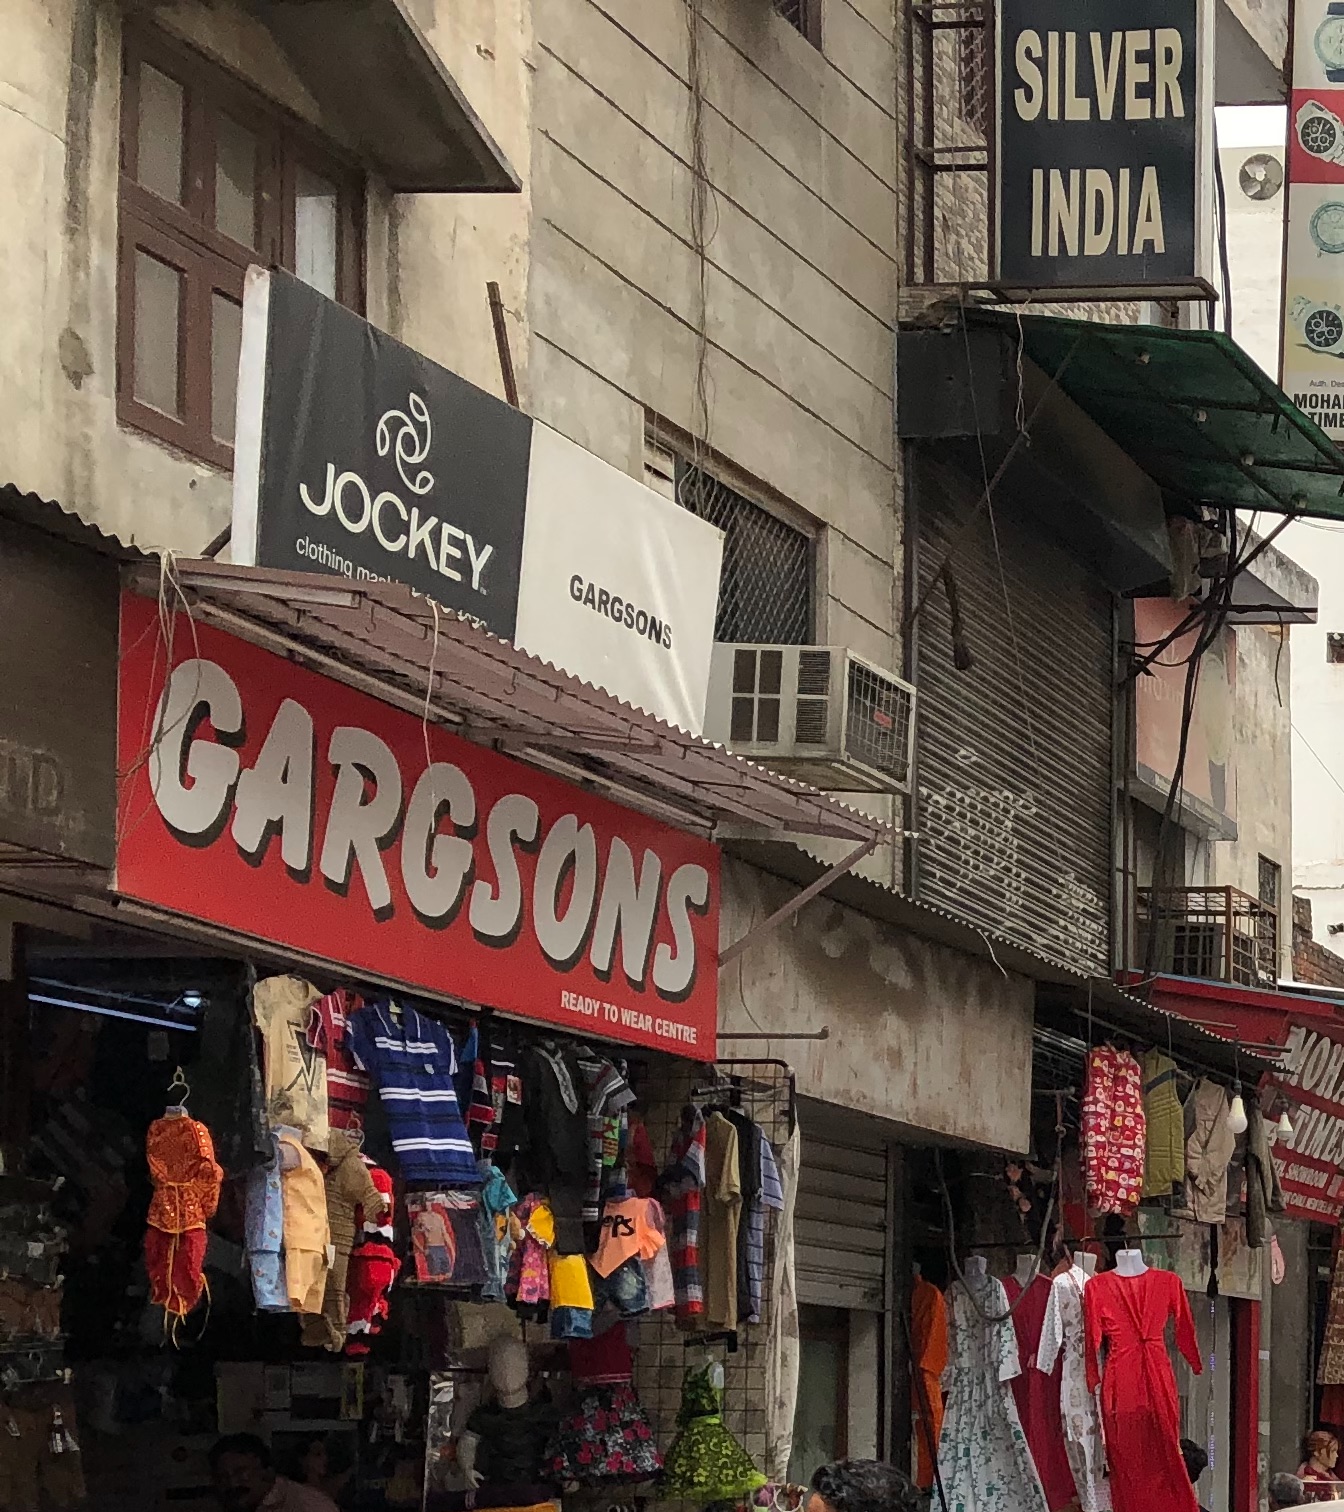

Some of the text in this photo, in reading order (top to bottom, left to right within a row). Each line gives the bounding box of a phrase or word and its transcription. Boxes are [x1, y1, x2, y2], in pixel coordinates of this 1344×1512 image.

[1015, 27, 1186, 122] SILVER
[1031, 165, 1165, 257] INDIA
[296, 535, 352, 579] clothing
[299, 462, 493, 591] JOCKEY
[569, 574, 673, 650] GARGSONS
[148, 657, 710, 1000] GARGSONS
[560, 990, 697, 1045] READY TO WEAR CENTRE
